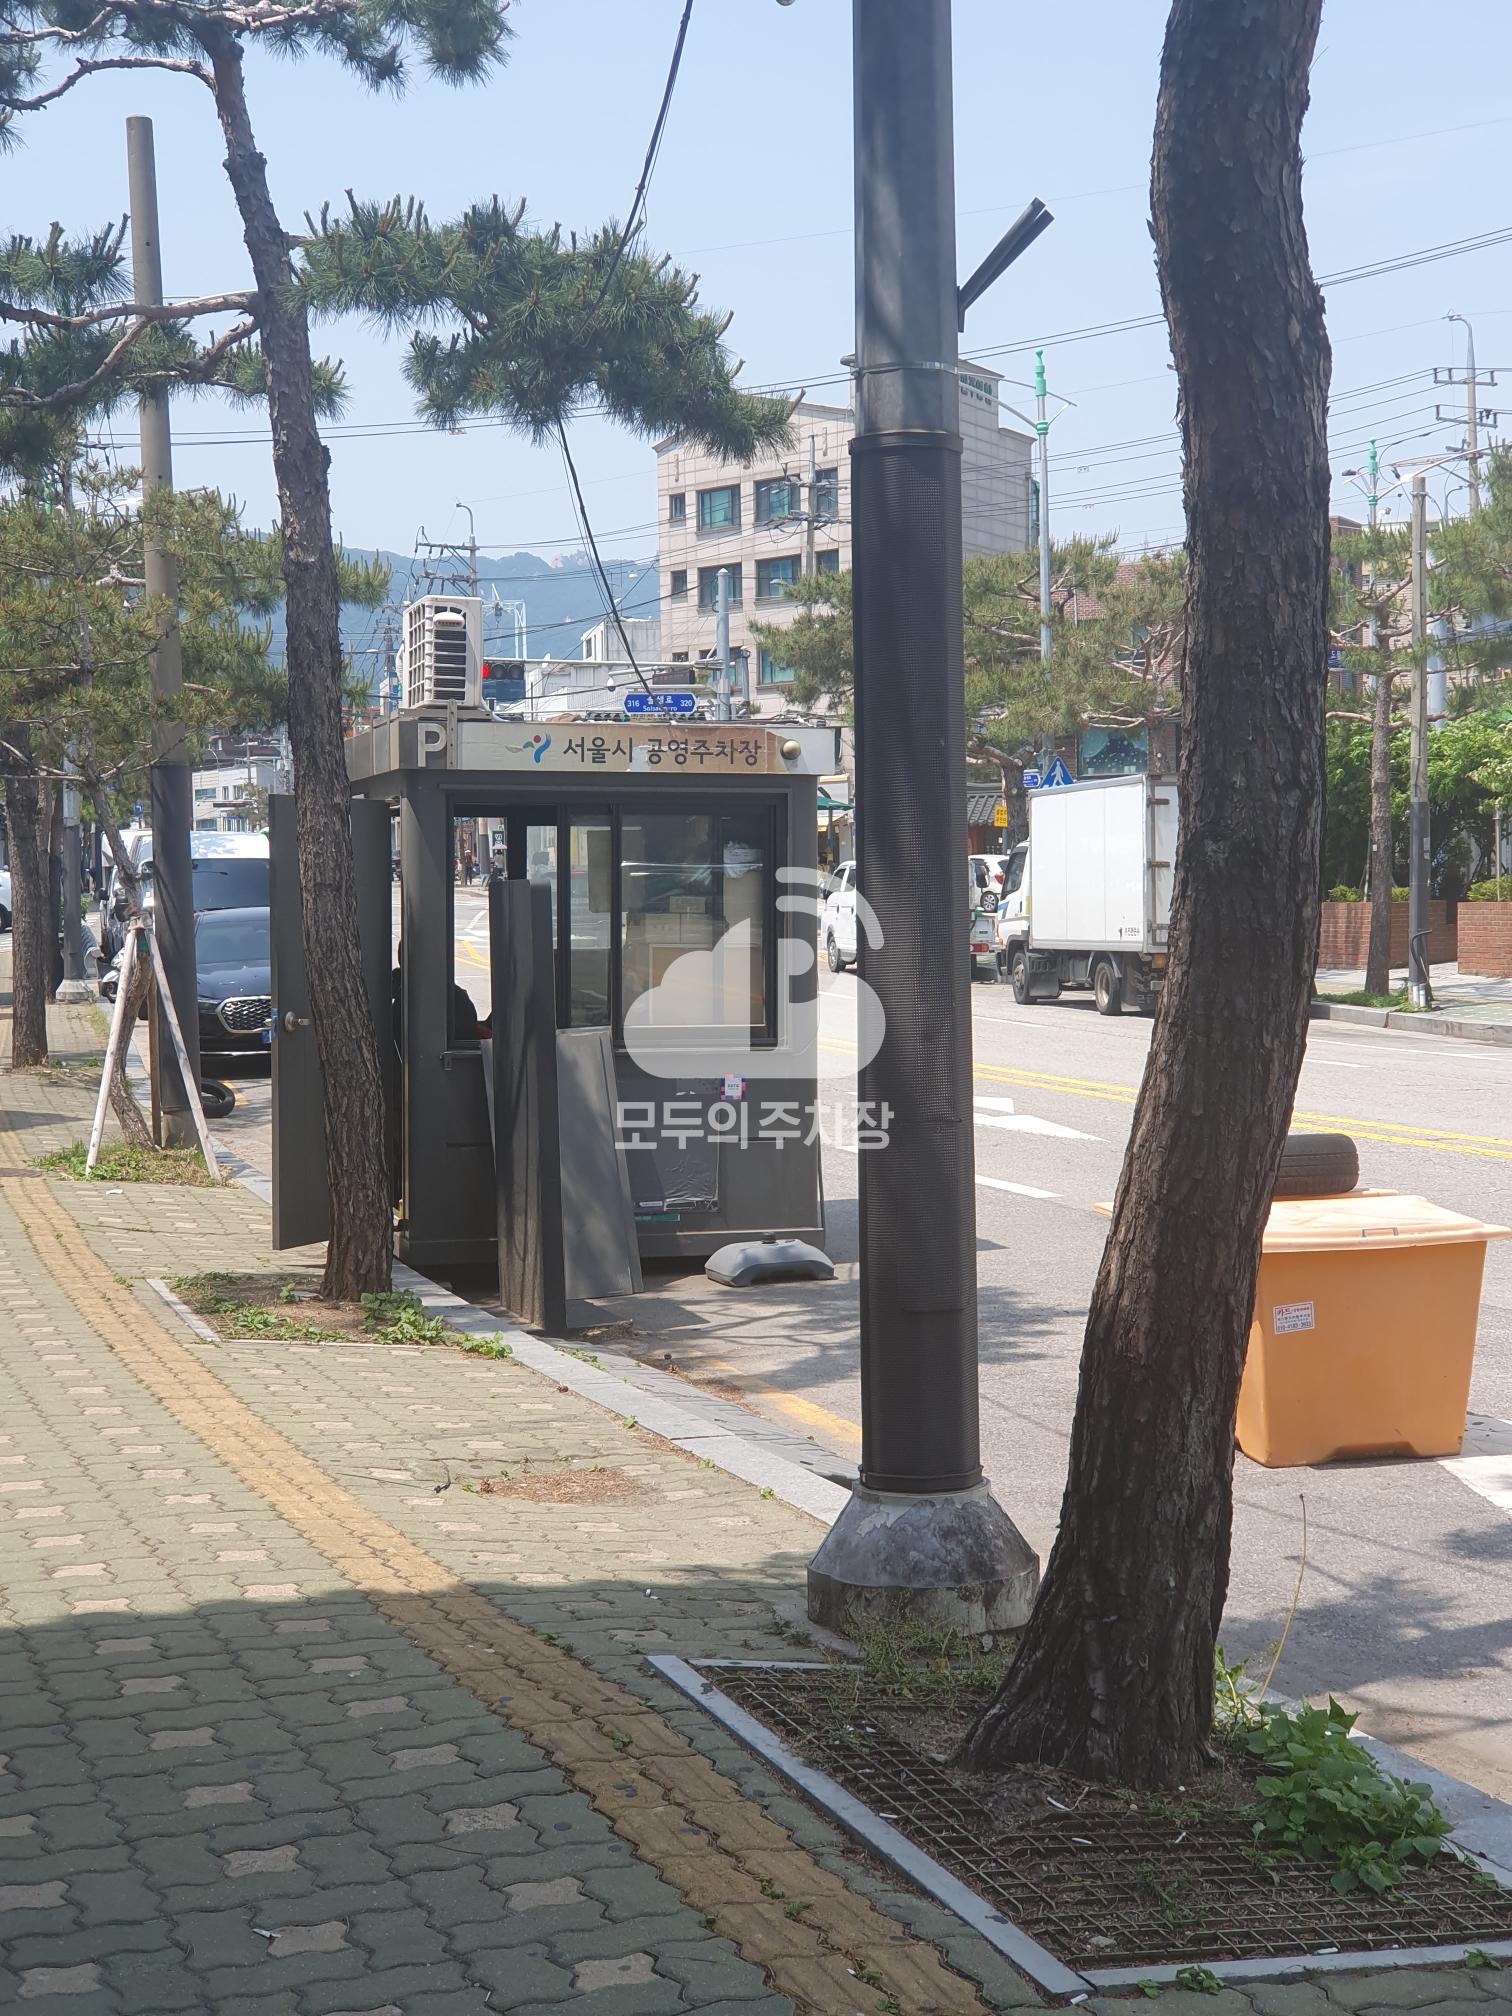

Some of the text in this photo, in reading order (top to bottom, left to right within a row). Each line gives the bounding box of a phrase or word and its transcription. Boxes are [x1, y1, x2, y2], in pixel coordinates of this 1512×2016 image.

[680, 699, 692, 707] 320
[417, 723, 447, 767] P
[563, 736, 763, 766] 서울시 공영주차장
